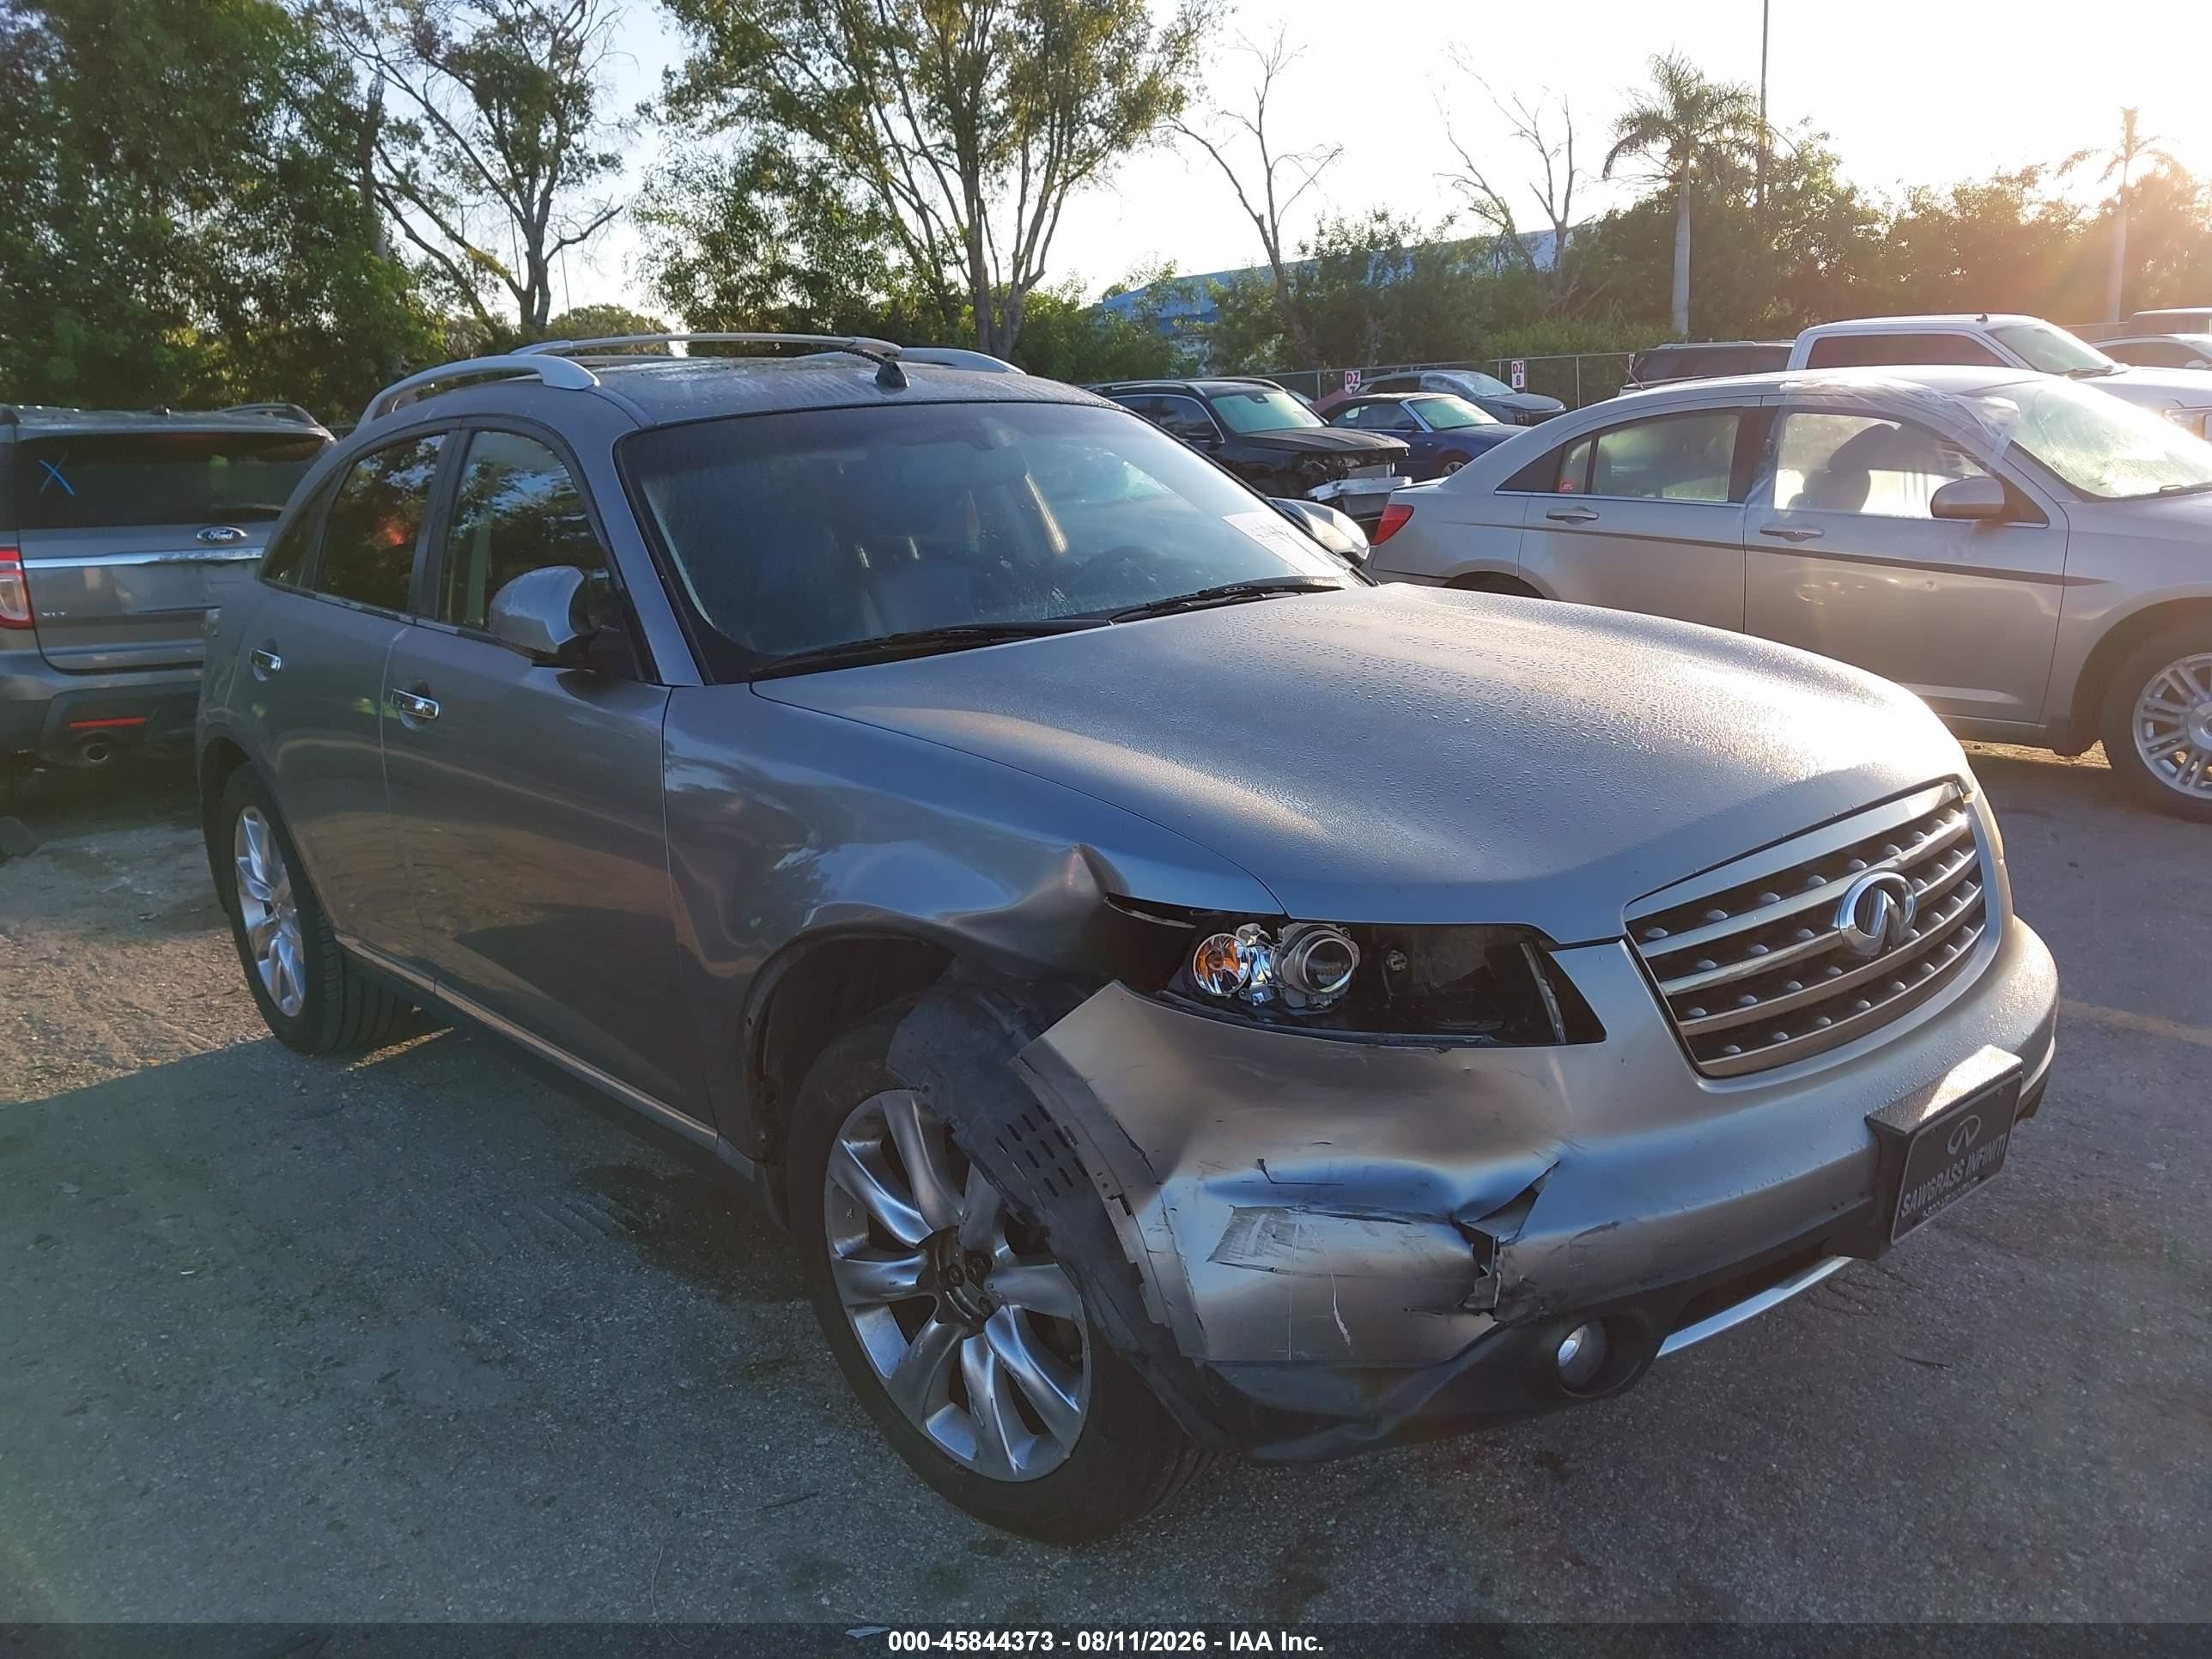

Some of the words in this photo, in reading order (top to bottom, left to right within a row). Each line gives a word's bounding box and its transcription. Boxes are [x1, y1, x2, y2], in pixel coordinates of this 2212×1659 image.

[1512, 362, 1523, 374] DZ
[1346, 372, 1359, 385] DZ
[1516, 374, 1522, 386] 8
[208, 529, 234, 540] Ford
[1901, 1158, 1966, 1218] SAWGRASS
[1966, 1133, 2008, 1177] INFINITI
